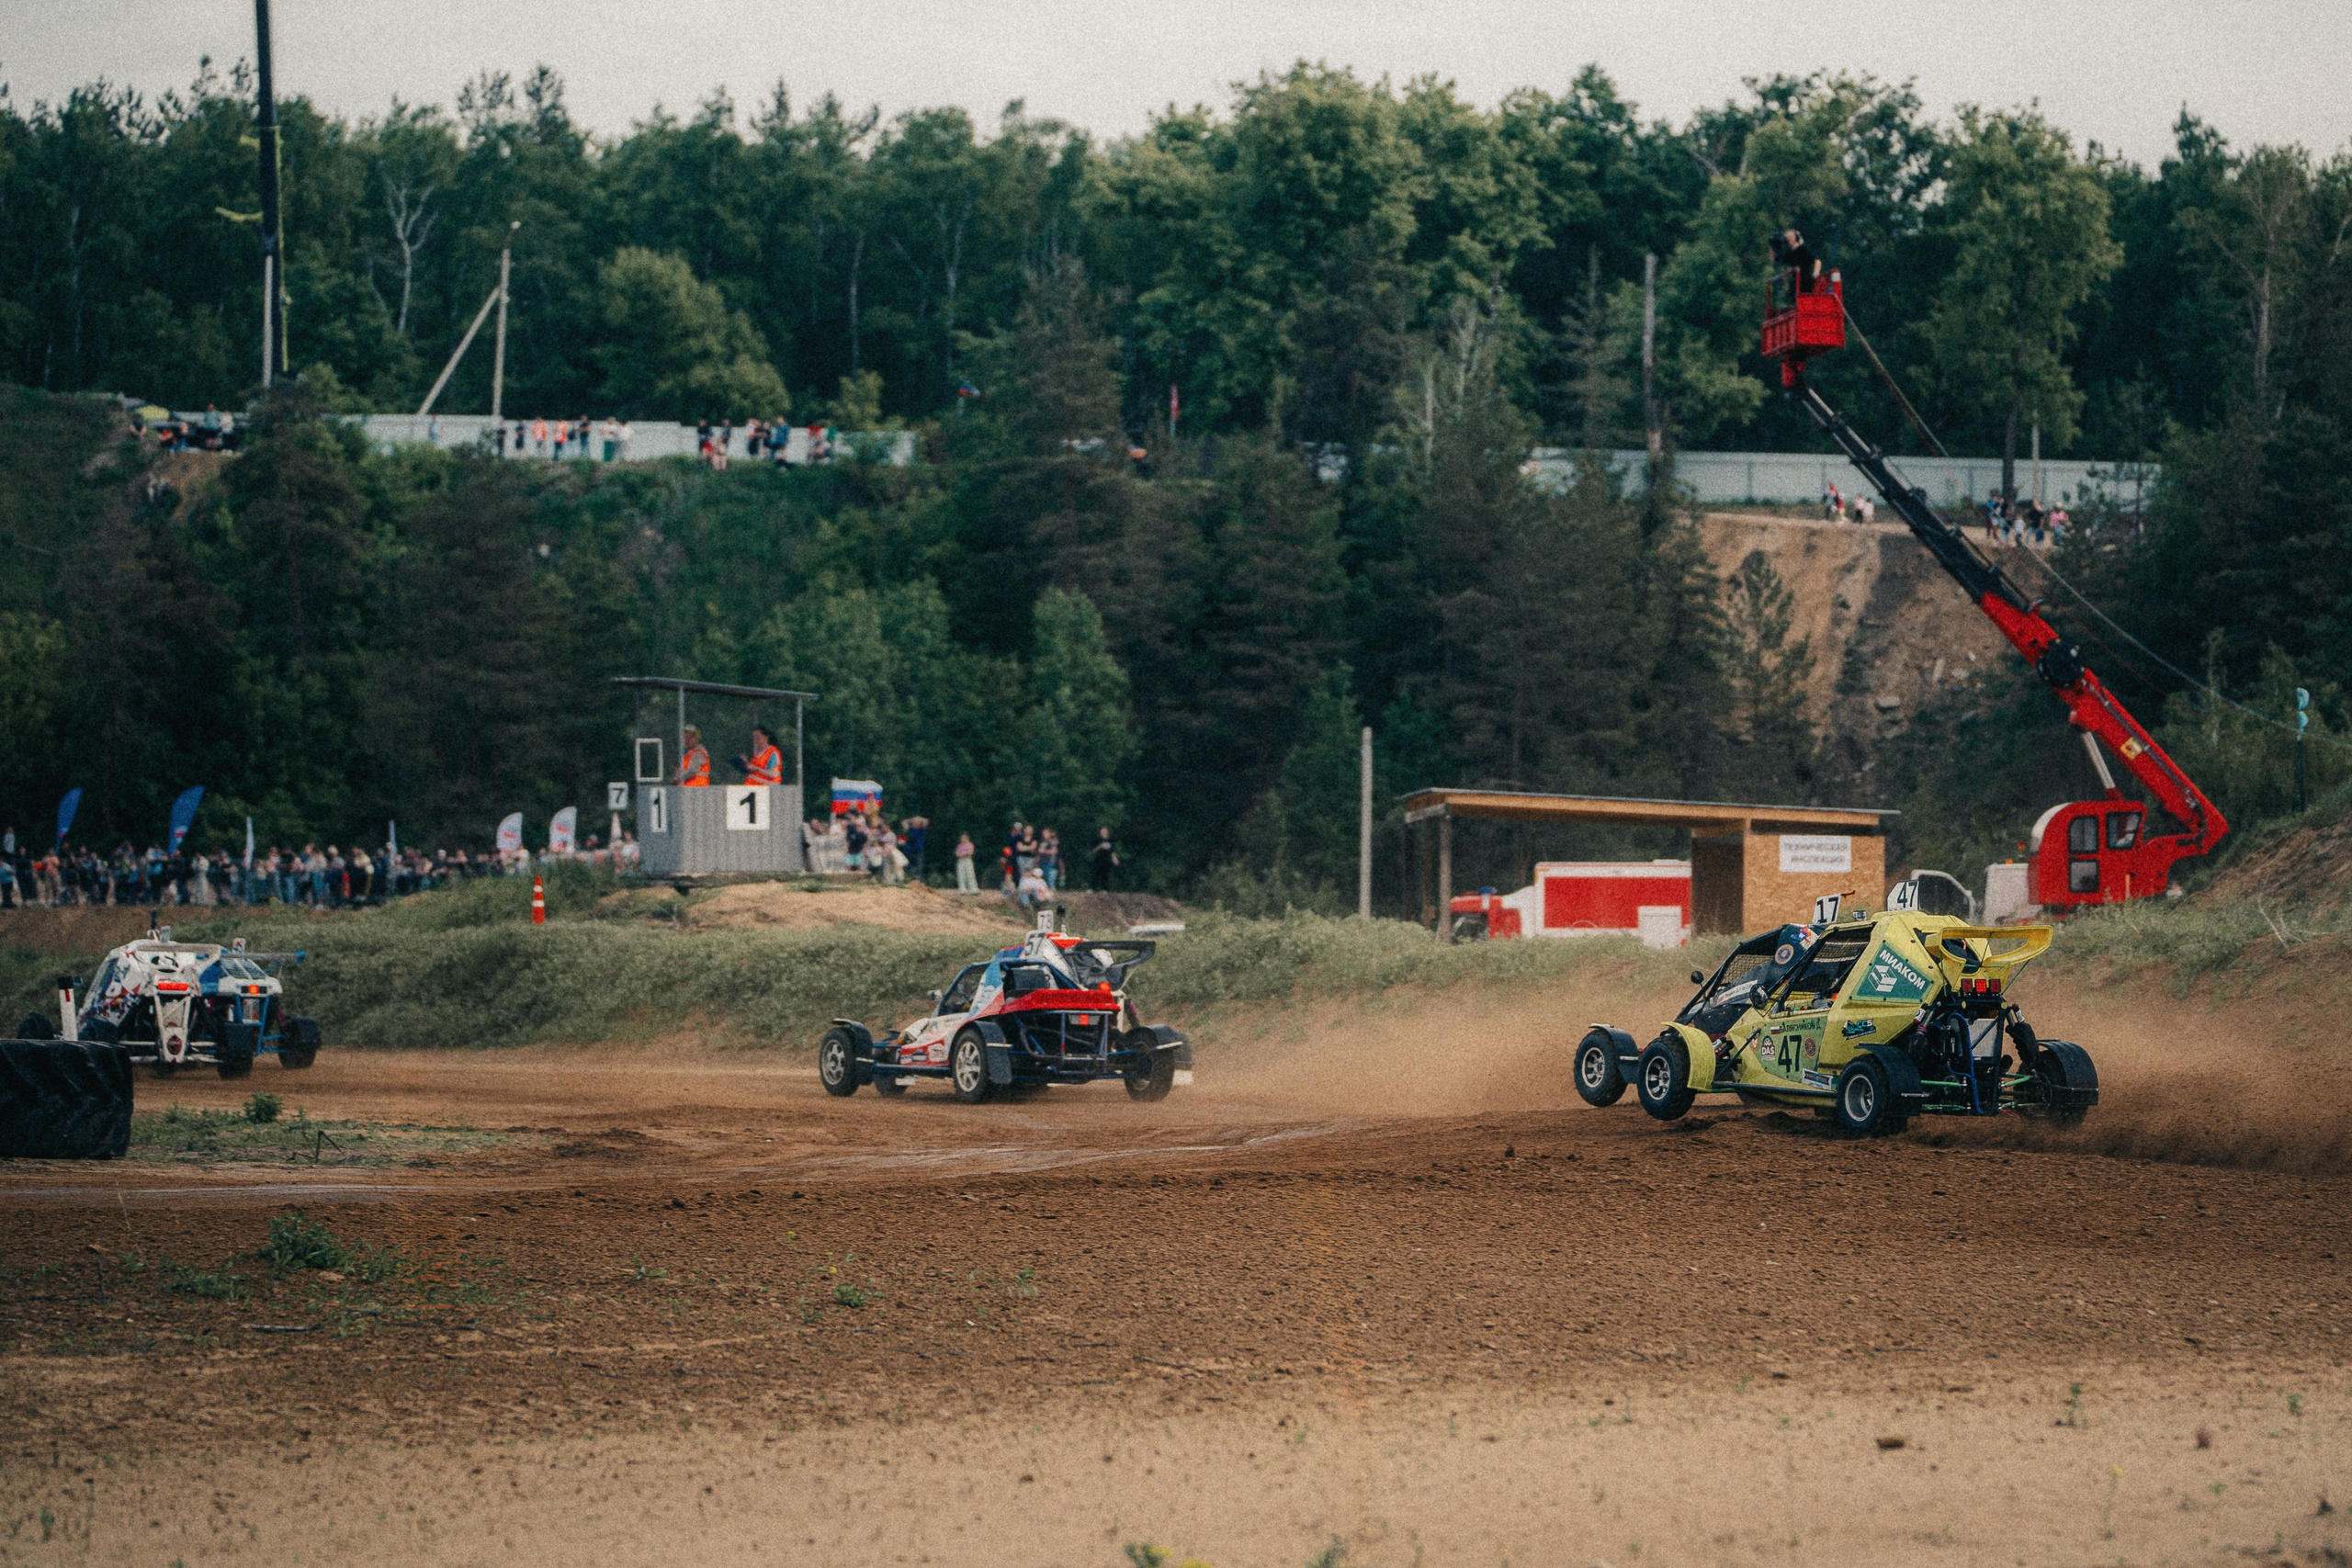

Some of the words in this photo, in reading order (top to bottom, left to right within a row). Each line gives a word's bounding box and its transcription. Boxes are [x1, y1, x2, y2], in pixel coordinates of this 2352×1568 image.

[612, 787, 624, 804] 7
[654, 790, 662, 829] 1
[740, 792, 756, 824] 1
[1897, 880, 1918, 908] 47
[1816, 897, 1839, 923] 17
[1025, 932, 1046, 957] 57
[1879, 949, 1926, 990] МИАКОМ
[1761, 1046, 1775, 1055] DAS
[1778, 1034, 1802, 1073] 47
